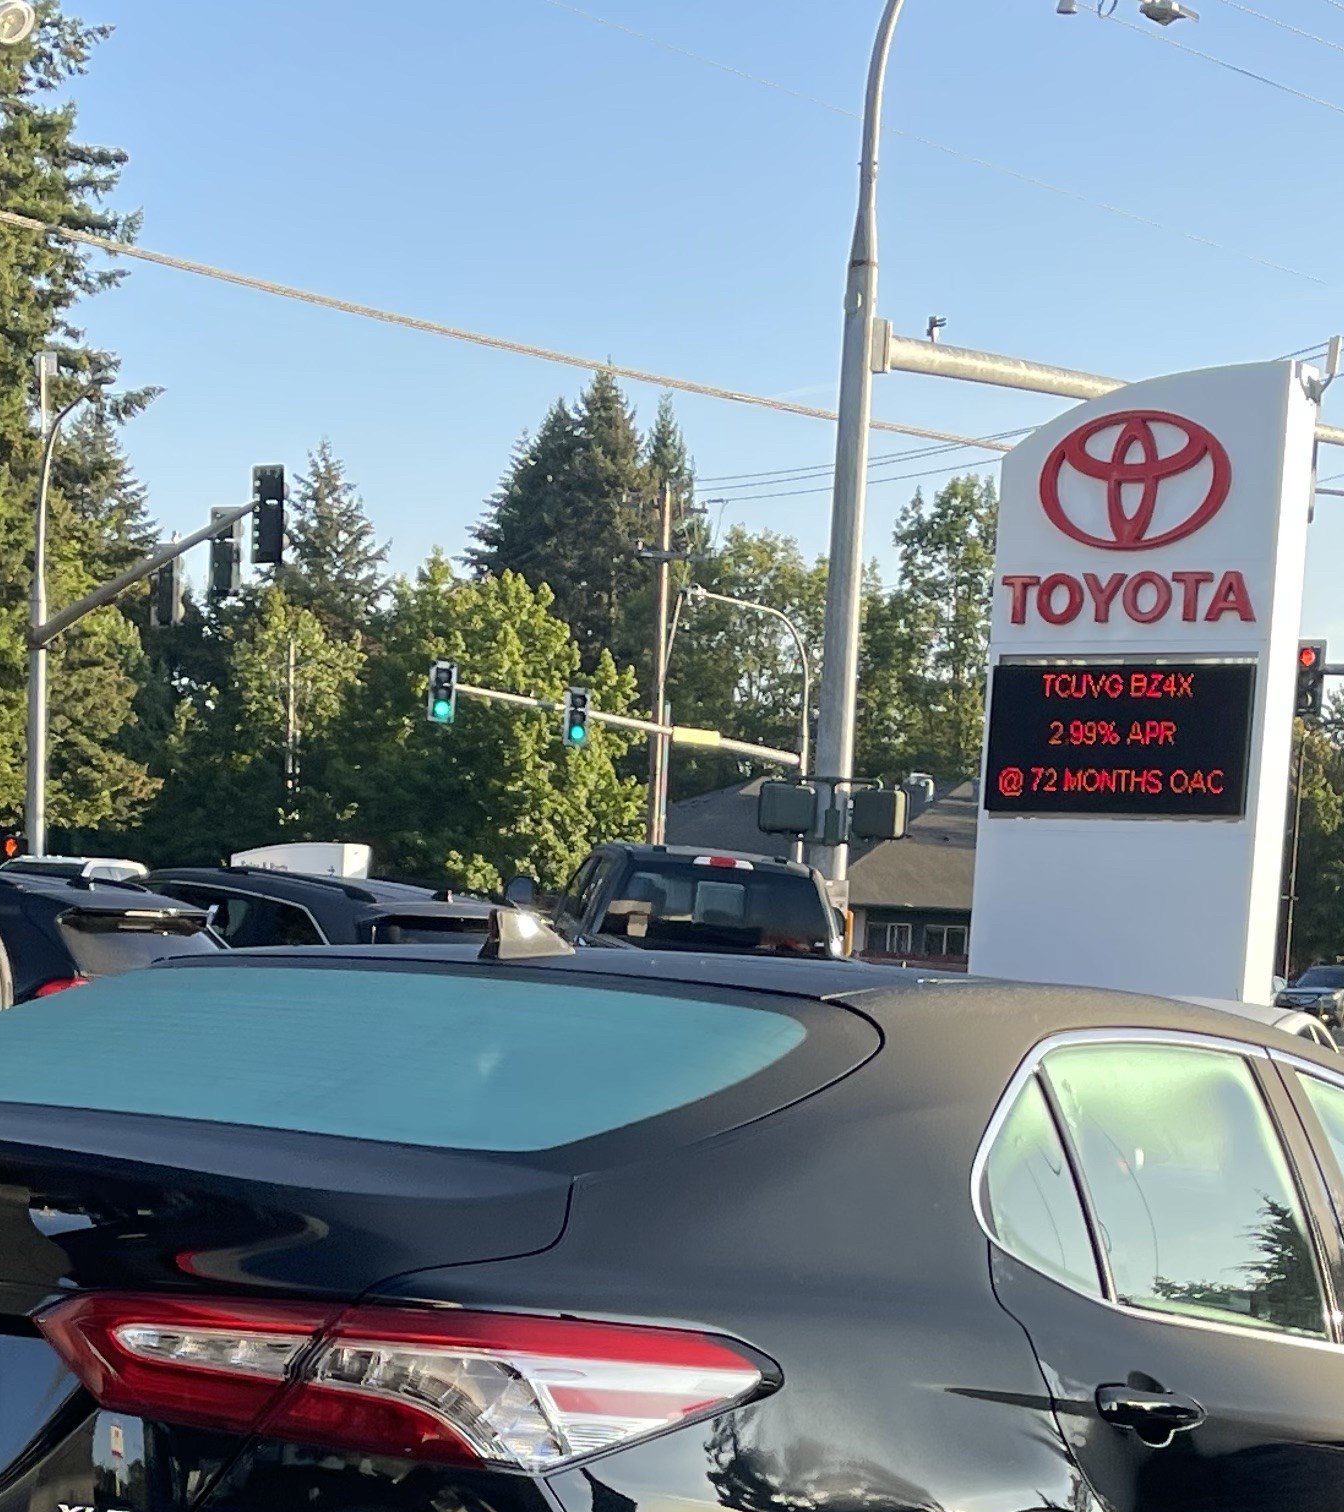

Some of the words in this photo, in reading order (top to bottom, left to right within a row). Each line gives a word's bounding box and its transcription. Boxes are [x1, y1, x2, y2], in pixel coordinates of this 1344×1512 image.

[1002, 570, 1257, 625] TOYOTA
[1129, 672, 1195, 699] BZ4X
[1126, 719, 1177, 746] APR
[998, 766, 1025, 797] @
[1030, 766, 1058, 792] 72
[1062, 767, 1163, 795] MONTHS
[1169, 768, 1225, 795] OAC
